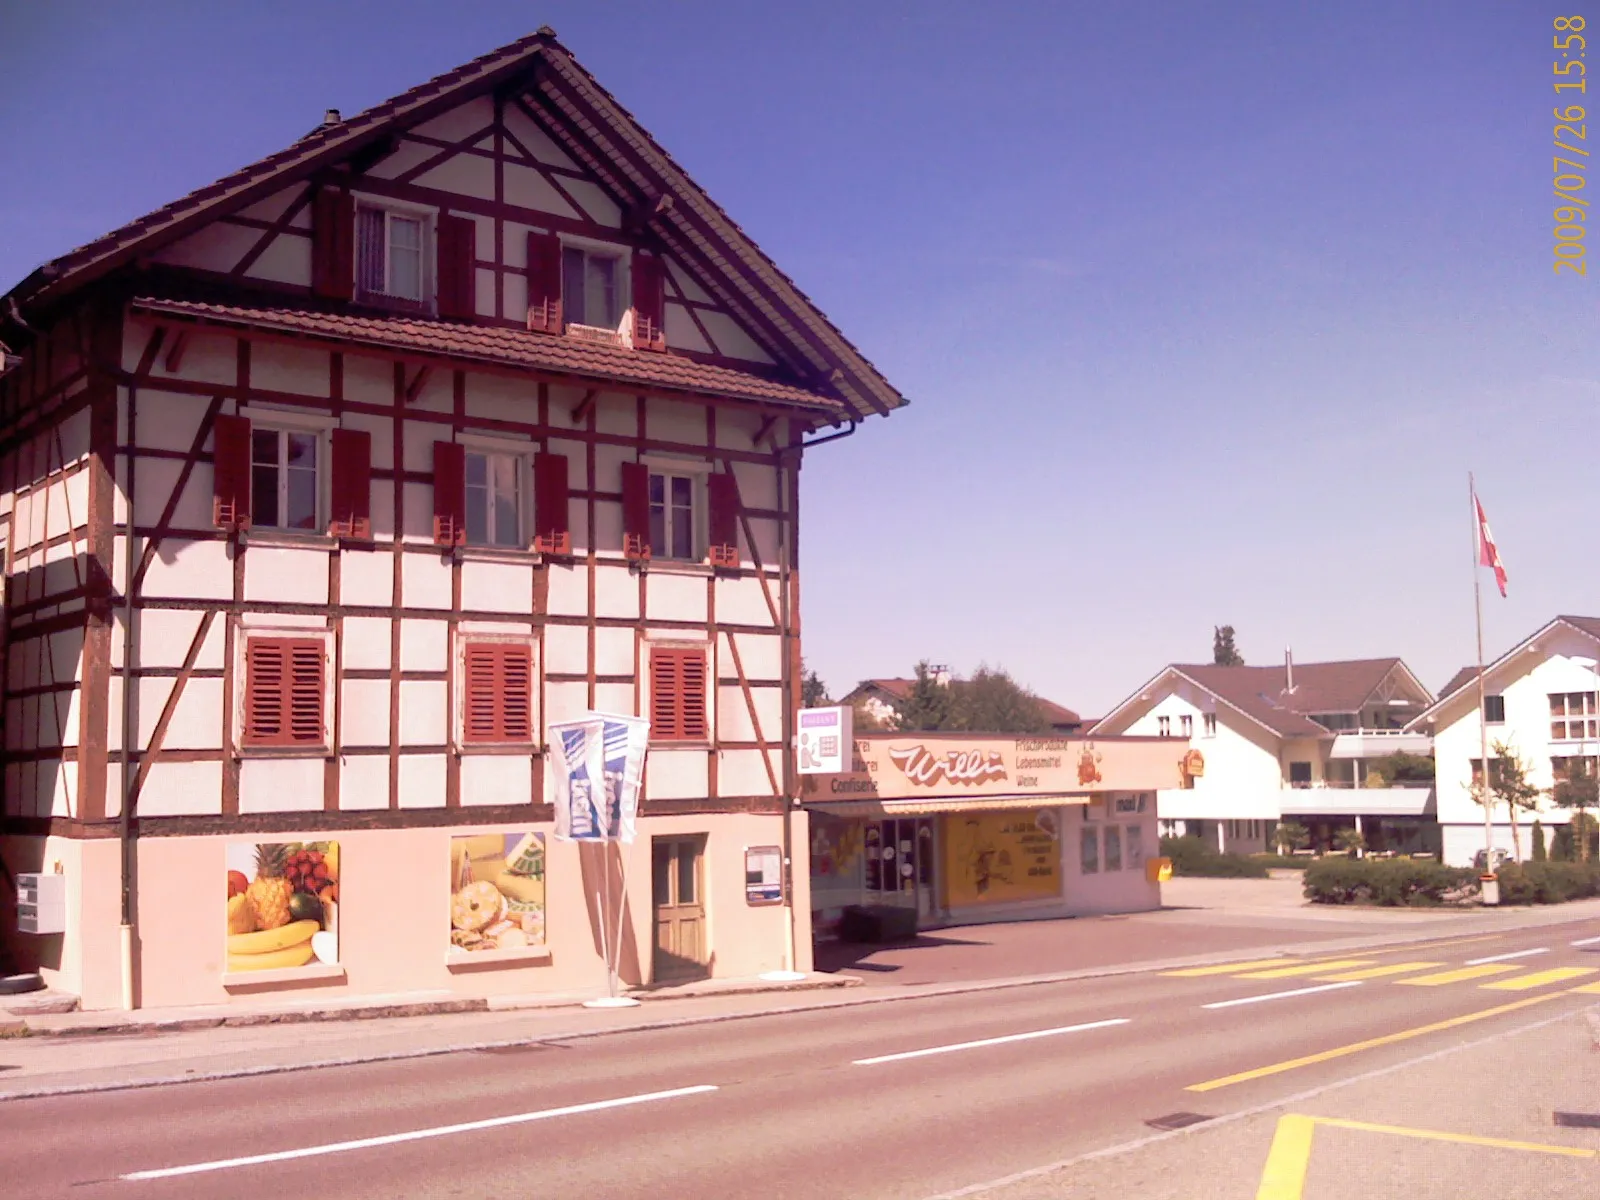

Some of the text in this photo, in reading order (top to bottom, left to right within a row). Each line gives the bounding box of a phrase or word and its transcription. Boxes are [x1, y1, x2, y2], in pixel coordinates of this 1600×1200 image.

[1015, 755, 1062, 769] Lebensmittel
[831, 776, 879, 795] Confiserie
[1015, 774, 1038, 787] Weine
